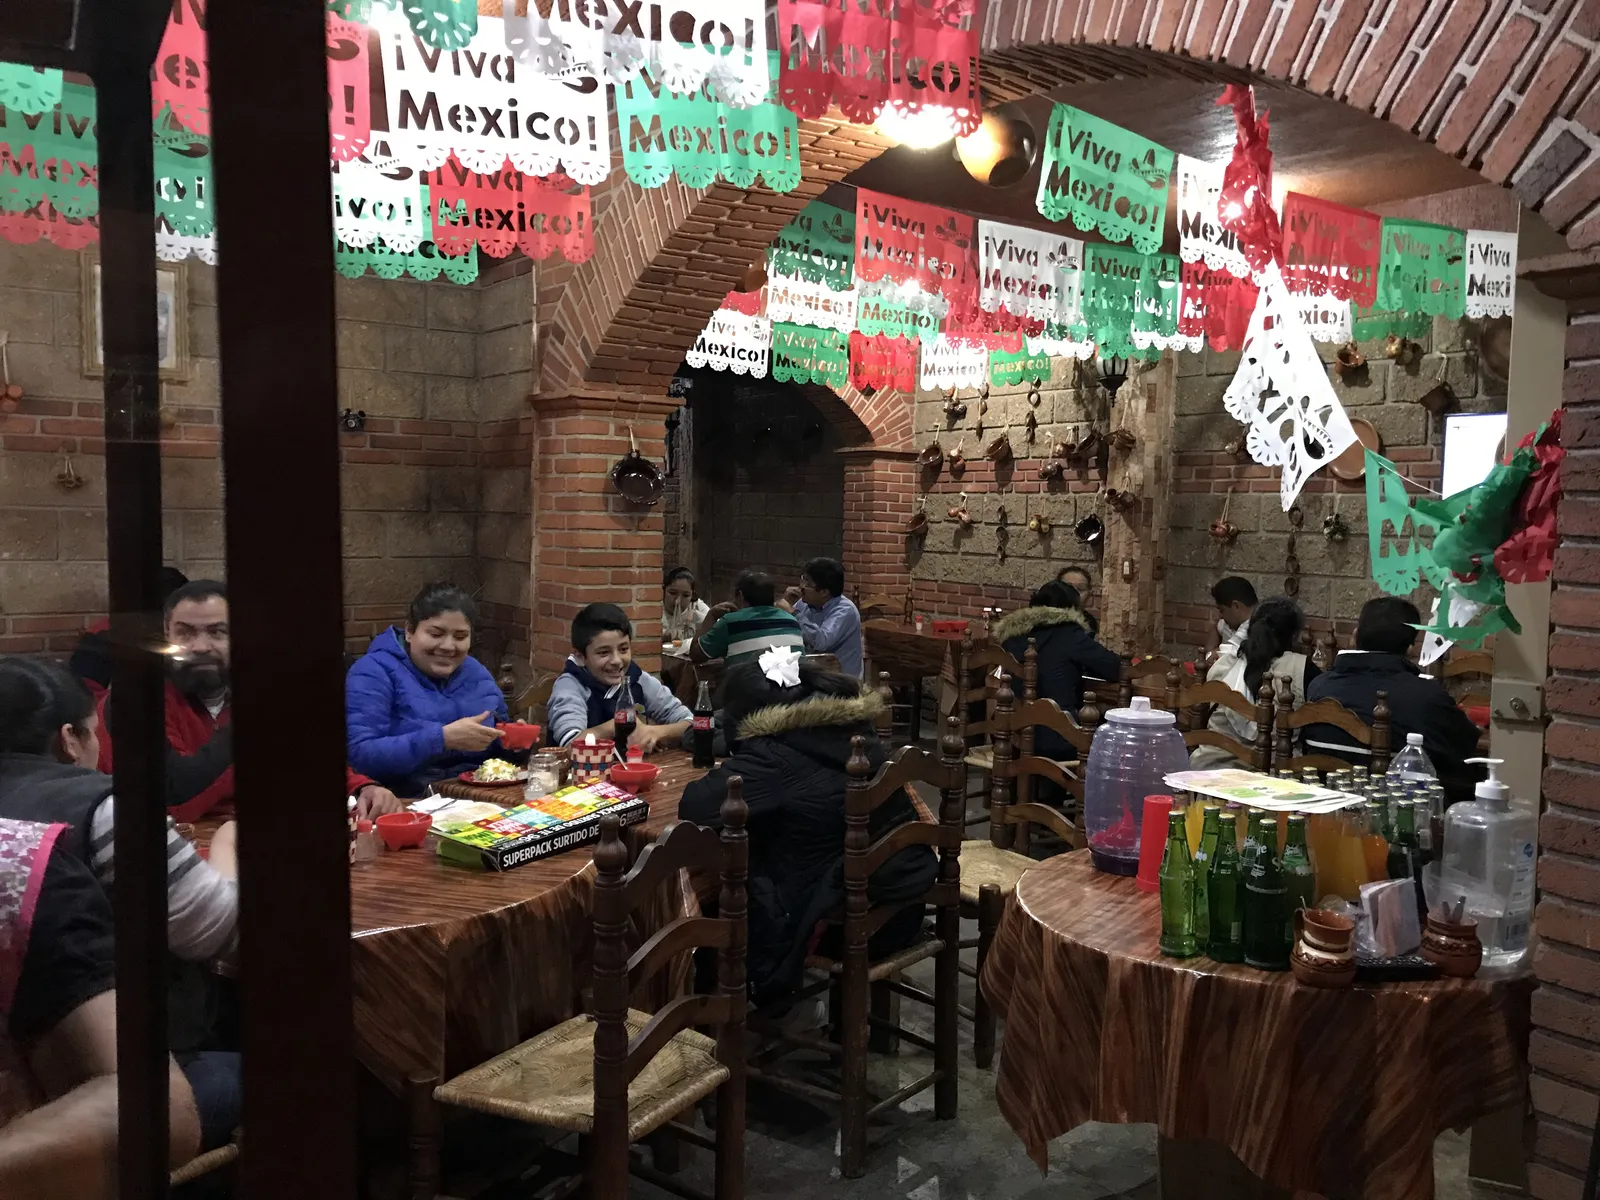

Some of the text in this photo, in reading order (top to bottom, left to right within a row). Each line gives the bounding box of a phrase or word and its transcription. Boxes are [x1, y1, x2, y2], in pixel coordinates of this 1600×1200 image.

[398, 89, 598, 152] Mexico!
[629, 114, 792, 161] Mexico!
[437, 197, 584, 239] Mexico!
[1044, 160, 1159, 233] Mexico!
[692, 337, 766, 365] Mexico!
[503, 840, 553, 867] SUPERPACK
[553, 828, 588, 850] SURTIDO
[589, 824, 600, 838] DE
